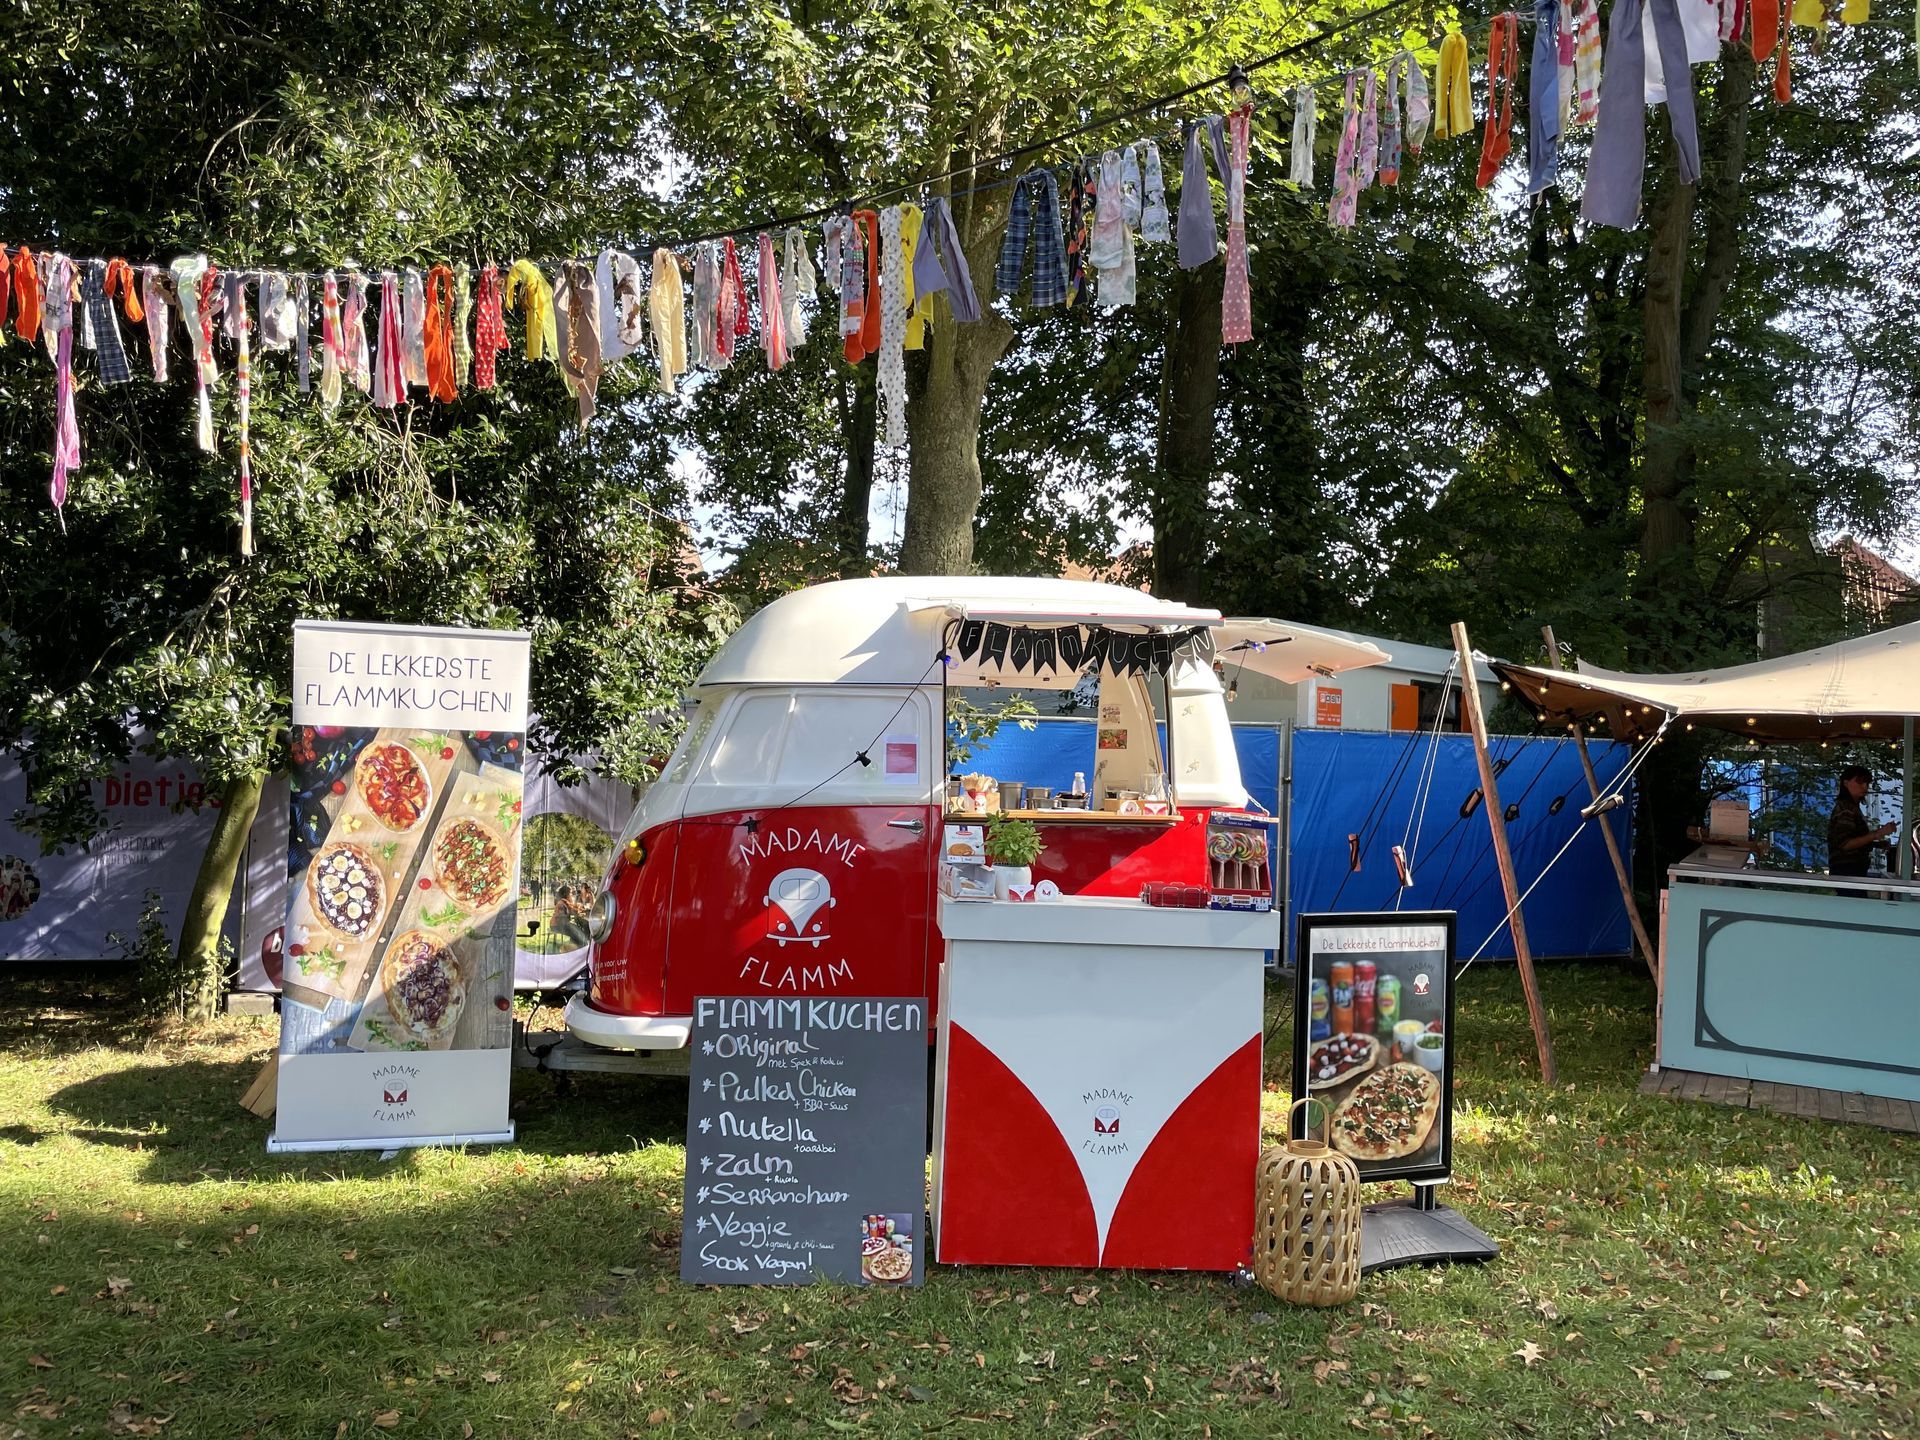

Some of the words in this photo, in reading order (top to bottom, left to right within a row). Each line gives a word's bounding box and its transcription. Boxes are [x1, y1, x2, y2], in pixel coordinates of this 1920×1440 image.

[329, 652, 356, 674] DE
[367, 653, 492, 680] LEKKERSTE
[305, 684, 512, 713] FLAMMKUCHEN!
[739, 827, 866, 867] MADAME
[1322, 938, 1334, 950] De
[1336, 938, 1377, 950] Lekkerste
[1379, 937, 1440, 950] Flammkuchen!
[739, 956, 854, 991] FLAMM
[372, 1065, 420, 1080] MADAME
[719, 1071, 796, 1101] Pulled
[799, 1068, 857, 1098] Chicken
[1082, 1088, 1134, 1106] MADAME
[373, 1109, 416, 1121] FLAMM
[1082, 1139, 1129, 1156] FLAMM
[715, 1152, 793, 1176] Zalm
[710, 1211, 792, 1249] Veggie
[754, 1252, 814, 1279] Vegan!
